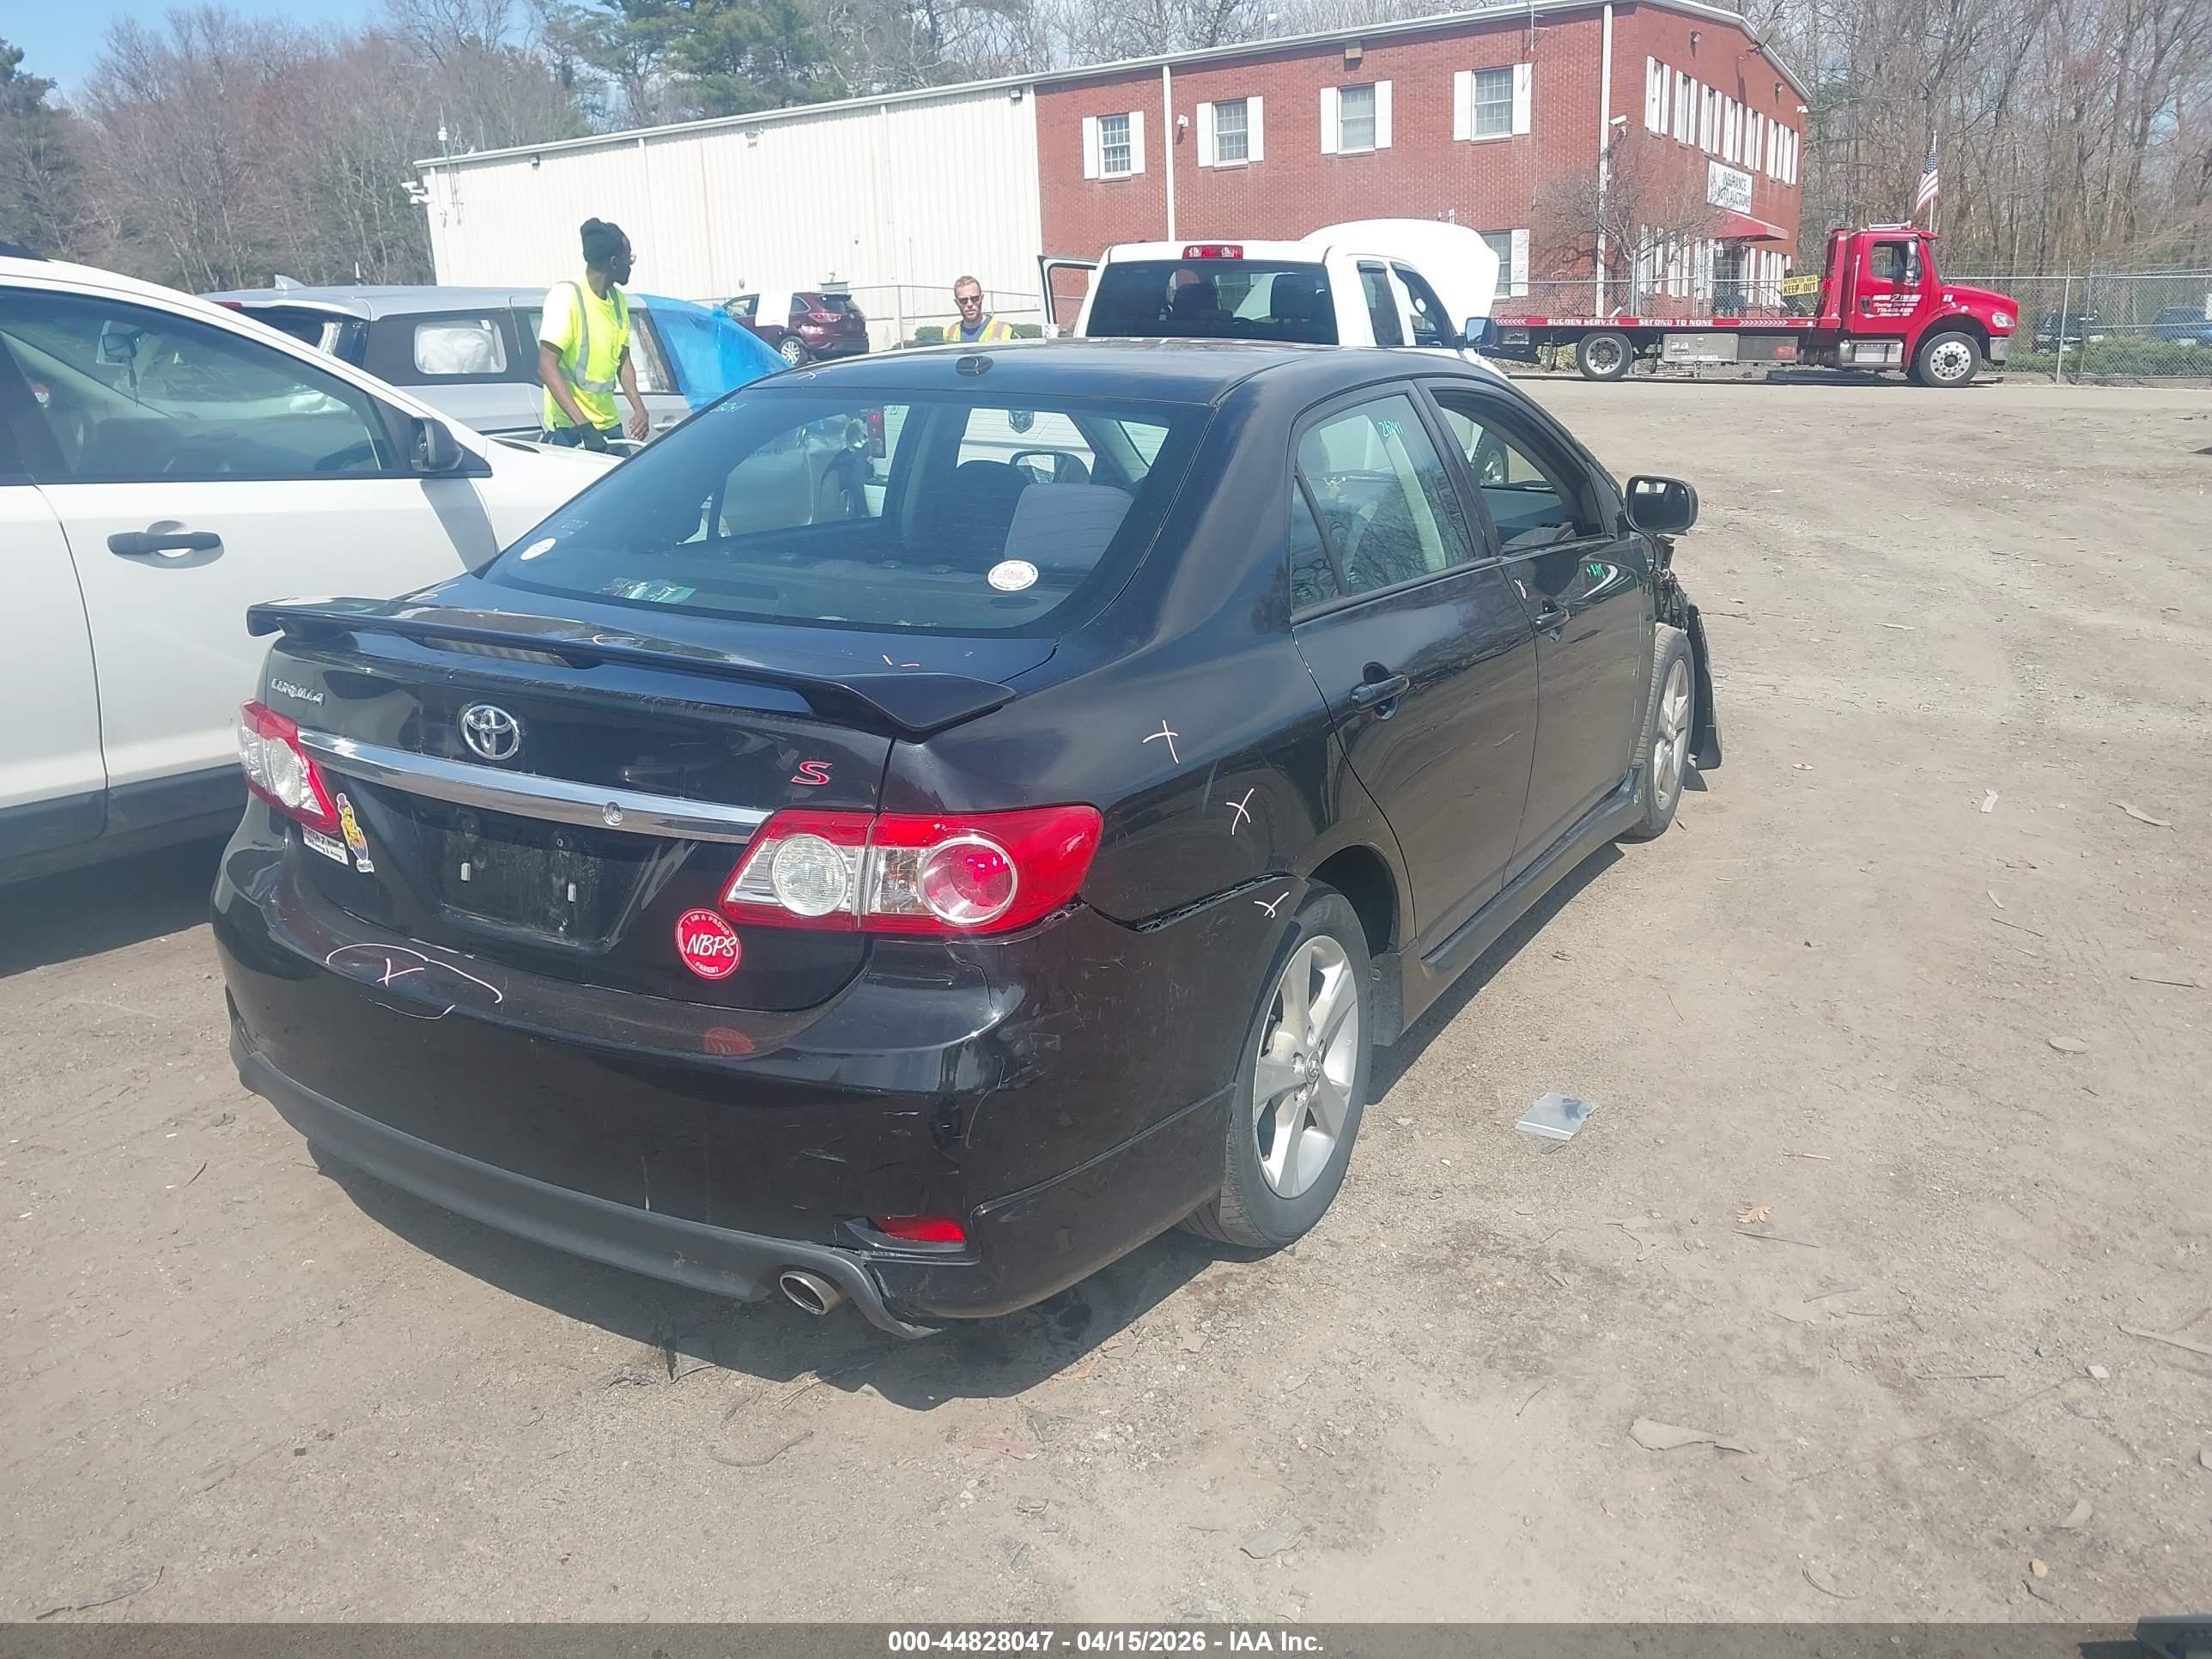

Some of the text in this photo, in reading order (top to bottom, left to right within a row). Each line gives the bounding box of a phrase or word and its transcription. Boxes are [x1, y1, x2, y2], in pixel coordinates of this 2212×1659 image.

[1784, 282, 1816, 295] KEEP OUT
[791, 761, 833, 785] S
[708, 915, 731, 936] PROUD
[686, 933, 738, 957] NBPS
[695, 961, 720, 973] PARENT
